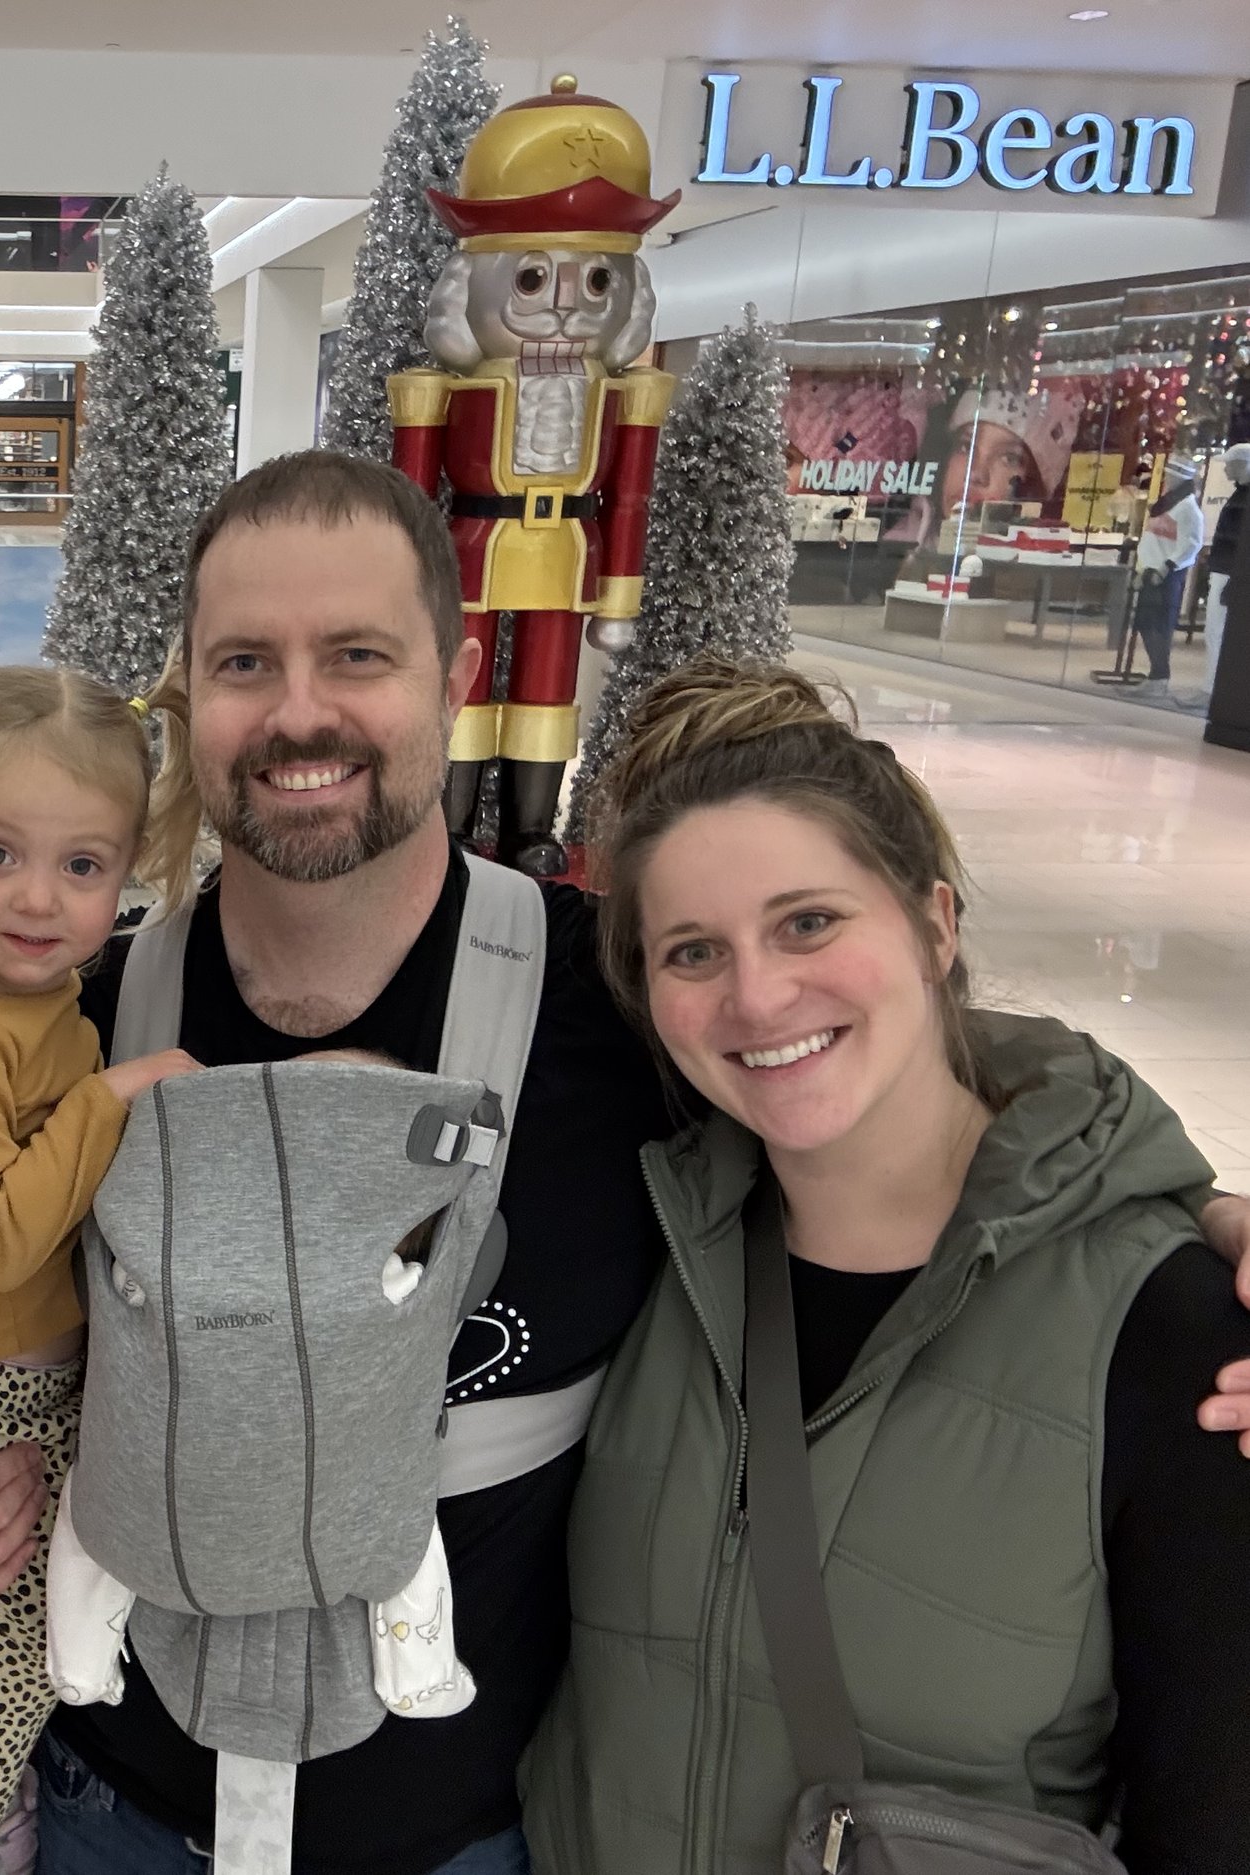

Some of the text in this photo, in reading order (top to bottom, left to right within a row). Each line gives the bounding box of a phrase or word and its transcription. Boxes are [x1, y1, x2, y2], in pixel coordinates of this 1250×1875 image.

[693, 72, 1195, 195] L.L.Bean
[798, 458, 939, 496] HOLIDAY SALE
